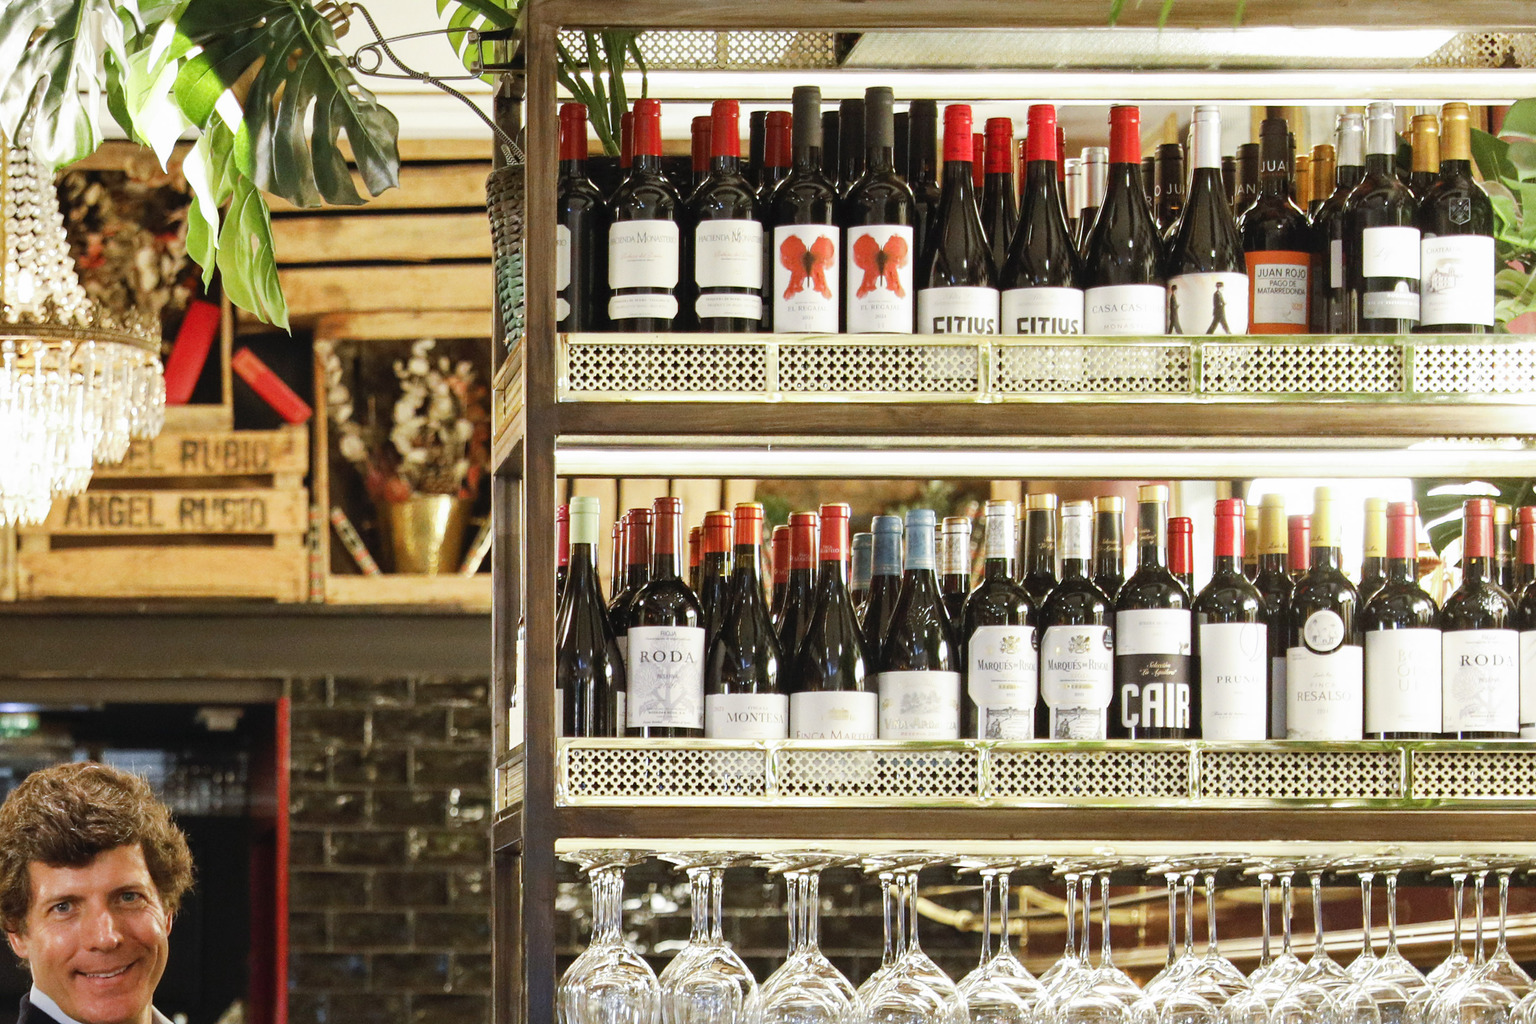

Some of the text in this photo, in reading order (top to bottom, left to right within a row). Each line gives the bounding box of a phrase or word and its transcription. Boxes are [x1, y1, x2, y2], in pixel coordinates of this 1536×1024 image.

[1258, 269, 1306, 279] JUAN ROJO
[1288, 280, 1296, 288] DE
[1258, 288, 1306, 296] MATARREDONDA
[1092, 304, 1118, 313] CASA
[933, 316, 994, 335] CITIUS
[1017, 316, 1078, 335] CITIUS
[64, 495, 165, 528] ANGEL
[640, 650, 694, 663] RODA
[1460, 654, 1514, 667] RODA
[977, 658, 1013, 672] MARQUÉS
[1048, 658, 1082, 672] MARQUÉS
[1297, 691, 1351, 702] RESALSO
[1121, 682, 1190, 728] CAIR
[726, 712, 784, 723] MONTESA
[796, 730, 825, 740] FINCA
